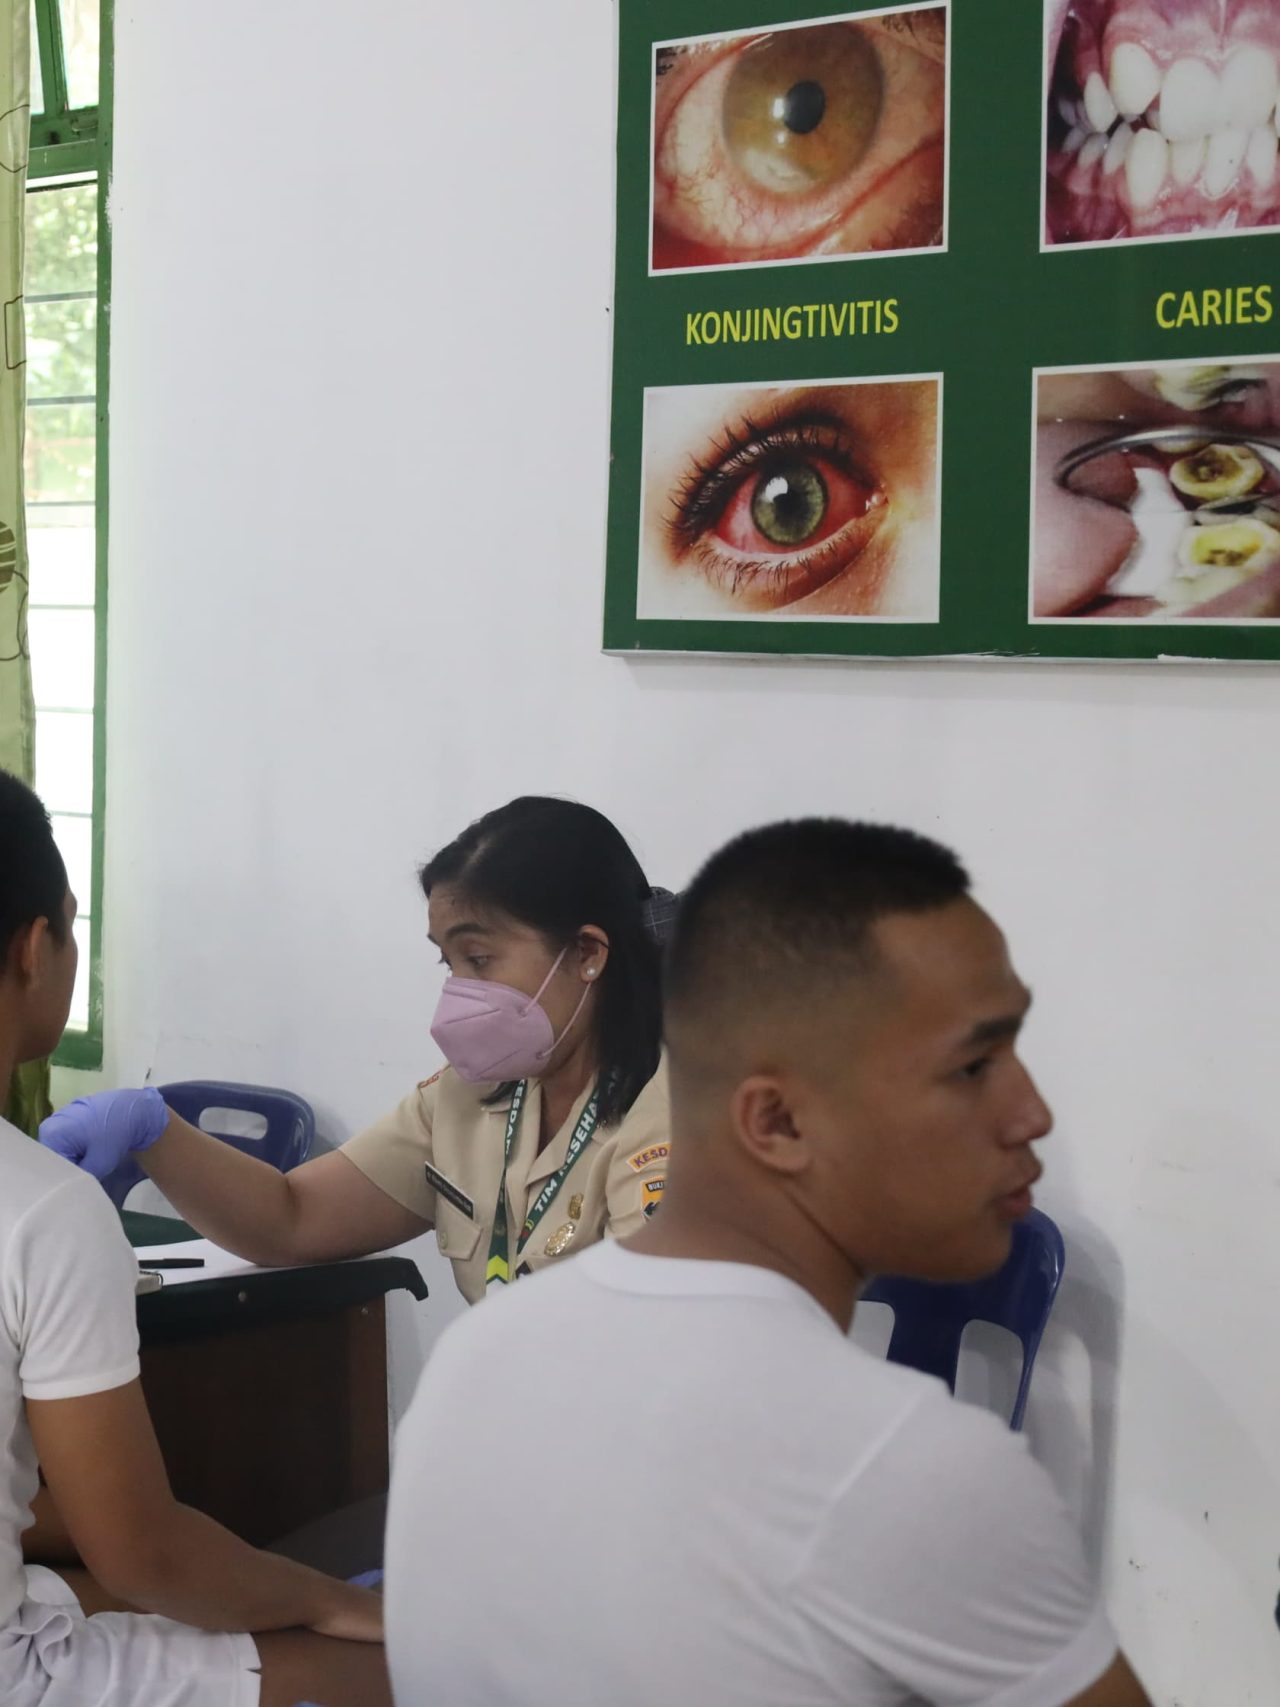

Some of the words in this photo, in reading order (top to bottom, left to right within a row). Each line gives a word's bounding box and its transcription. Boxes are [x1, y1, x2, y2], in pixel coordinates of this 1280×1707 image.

[686, 299, 899, 345] KONJINGTIVITIS
[1156, 285, 1273, 329] CARIES
[634, 1147, 669, 1168] KESD
[534, 1178, 558, 1213] TIM
